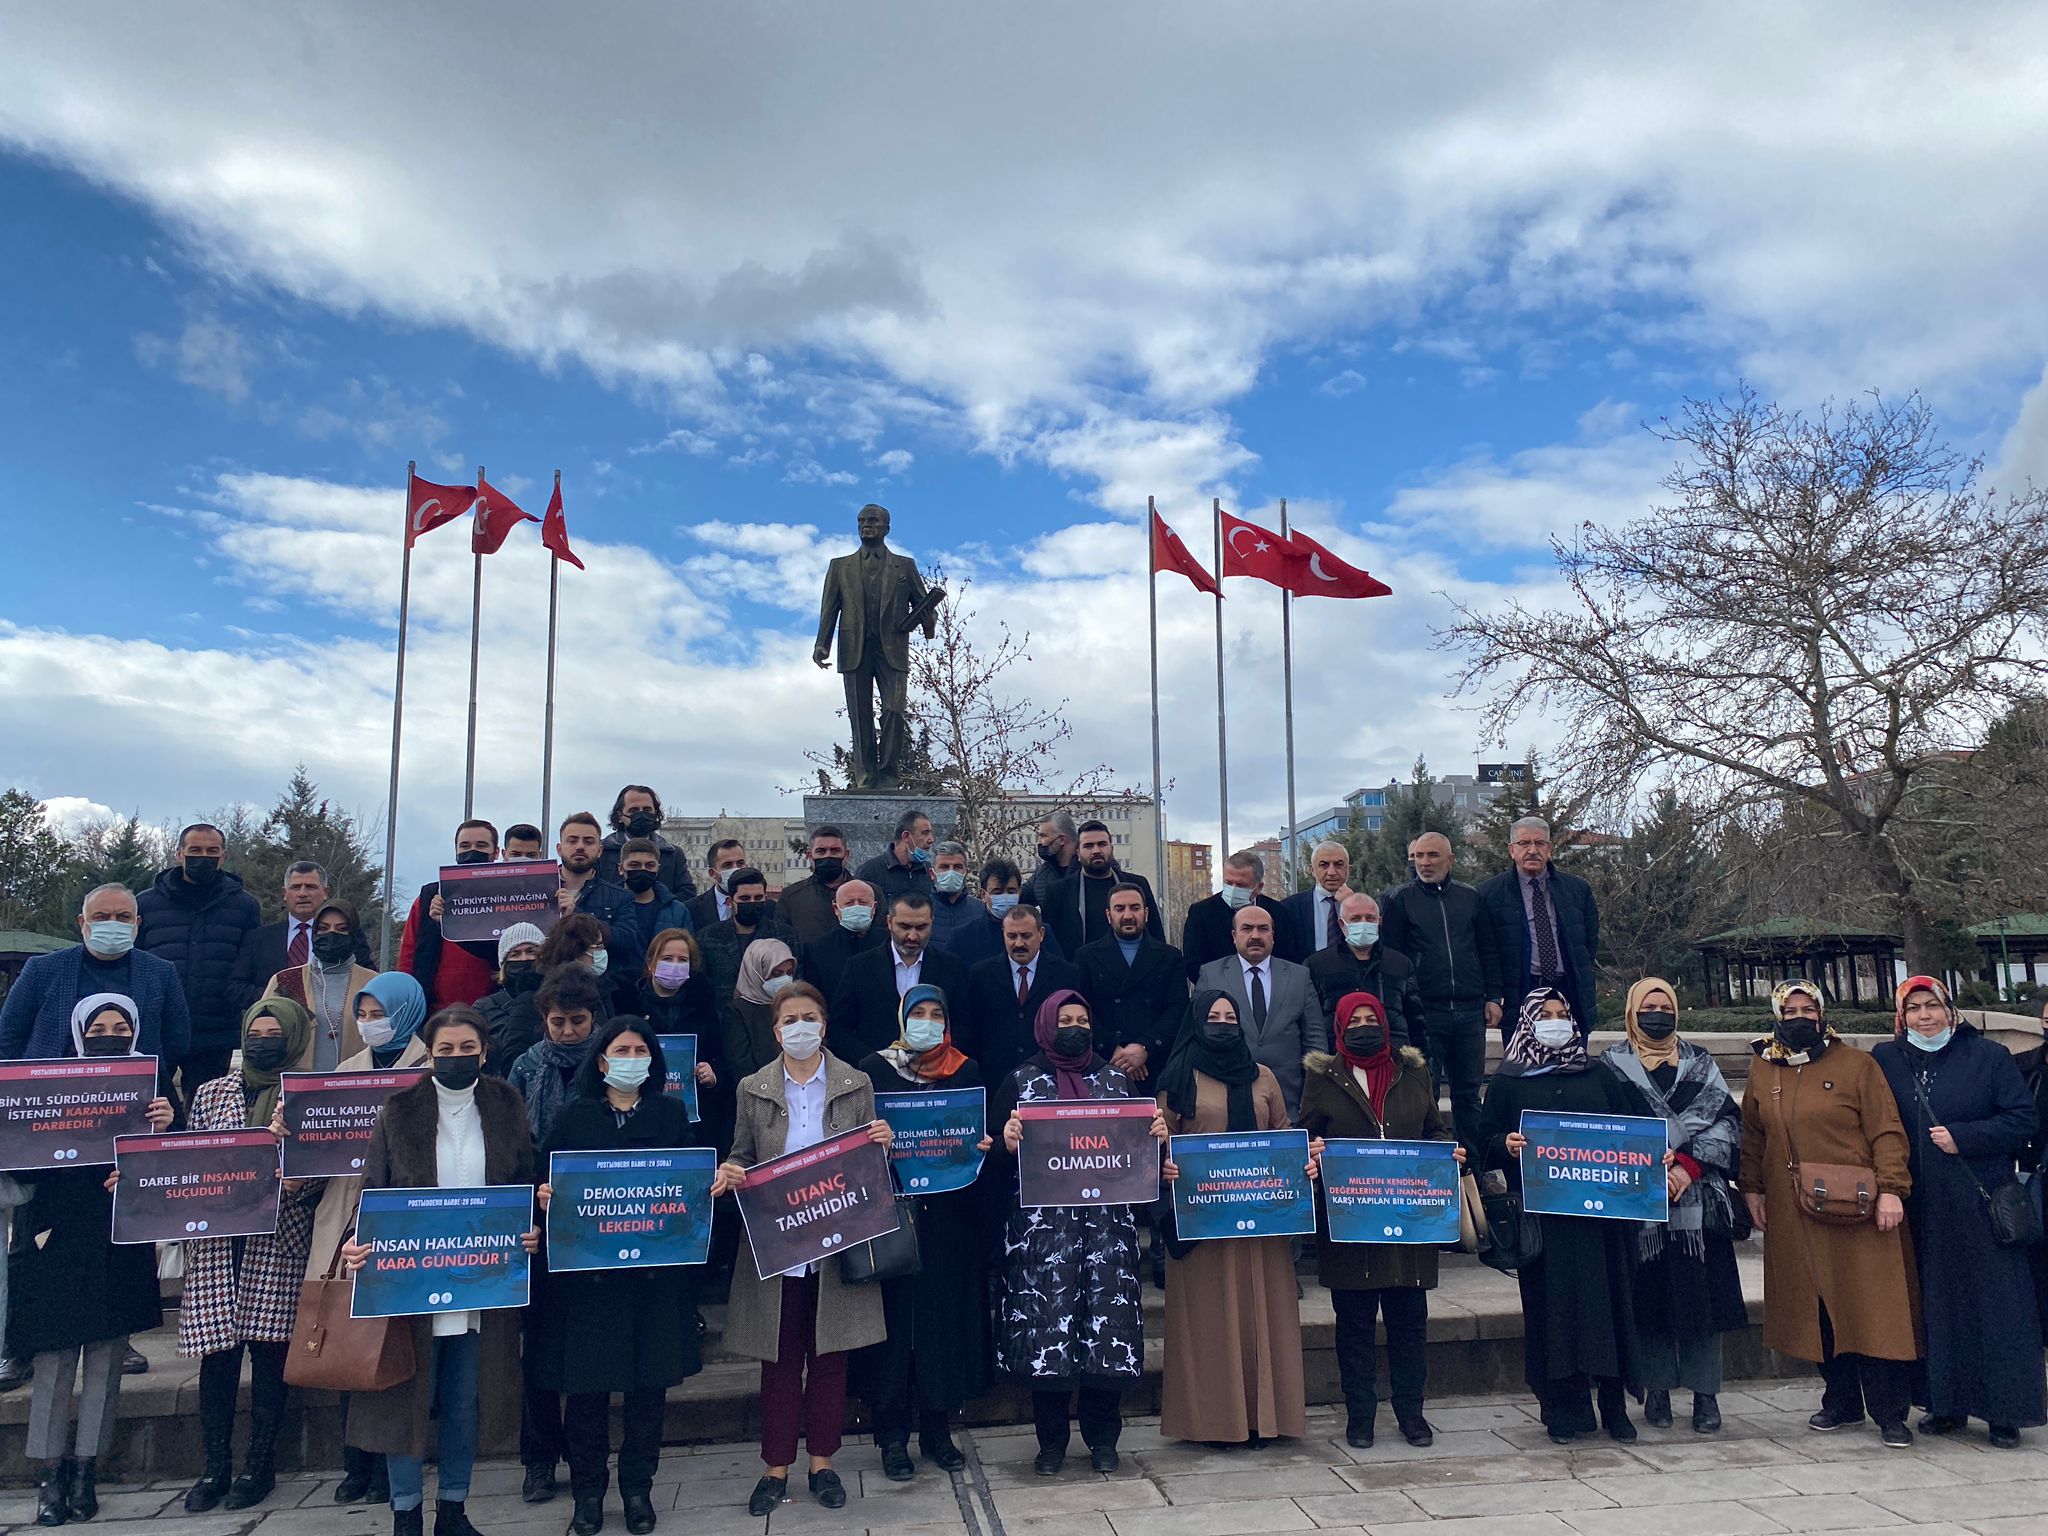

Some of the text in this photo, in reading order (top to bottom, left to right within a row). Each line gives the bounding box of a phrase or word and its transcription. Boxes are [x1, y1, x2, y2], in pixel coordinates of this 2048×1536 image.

[509, 893, 548, 902] AYAĞINA
[451, 906, 492, 915] VURULAN
[495, 903, 544, 912] PRANGADIR
[24, 1097, 42, 1106] YIL
[47, 1092, 138, 1105] SÜRDÜRÜLMEK
[8, 1105, 127, 1120] İSTENEN KARANLIK
[306, 1107, 336, 1116] OKUL
[301, 1118, 350, 1129] MİLLETİN
[299, 1131, 372, 1141] KIRILAN ONU
[899, 1130, 940, 1139] EDİLMEDİ,
[943, 1127, 975, 1136] ISRARLA
[892, 1140, 917, 1151] NİLDİ,
[1070, 1133, 1109, 1150] İKNA
[915, 1149, 946, 1157] YAZILDI
[1537, 1146, 1651, 1166] POSTMODERN
[1048, 1154, 1131, 1170] OLMADIK !
[1209, 1166, 1275, 1178] UNUTMADIK !
[1549, 1166, 1639, 1185] DARBEDİR !
[140, 1171, 257, 1187] DARBE BİR İNSANLIK
[1197, 1178, 1283, 1191] UNUTMAYACAĞIZ
[1349, 1177, 1431, 1187] MİLLETİN KENDİSİNE,
[166, 1187, 223, 1199] SUÇUDUR
[584, 1183, 682, 1200] DEMOKRASİYE
[787, 1173, 846, 1205] UTANÇ
[1330, 1185, 1382, 1195] DEĞERLERİNE
[1397, 1188, 1452, 1198] İNANÇLARINA
[408, 1199, 442, 1207] POSTMODERN
[1188, 1189, 1293, 1204] UNUTTURMAYACAĞIZ
[1332, 1197, 1354, 1206] KARŞI
[1357, 1197, 1390, 1205] YAPILAN
[1393, 1197, 1404, 1205] BİR
[1407, 1198, 1445, 1206] DARBEDİR
[577, 1202, 687, 1217] VURULAN KARA
[776, 1187, 868, 1232] TARİHİDİR !
[599, 1218, 663, 1233] LEKEDİR !
[371, 1235, 515, 1252] İNSAN HAKLARININ
[377, 1251, 509, 1270] KARA GÜNÜDÜR !
